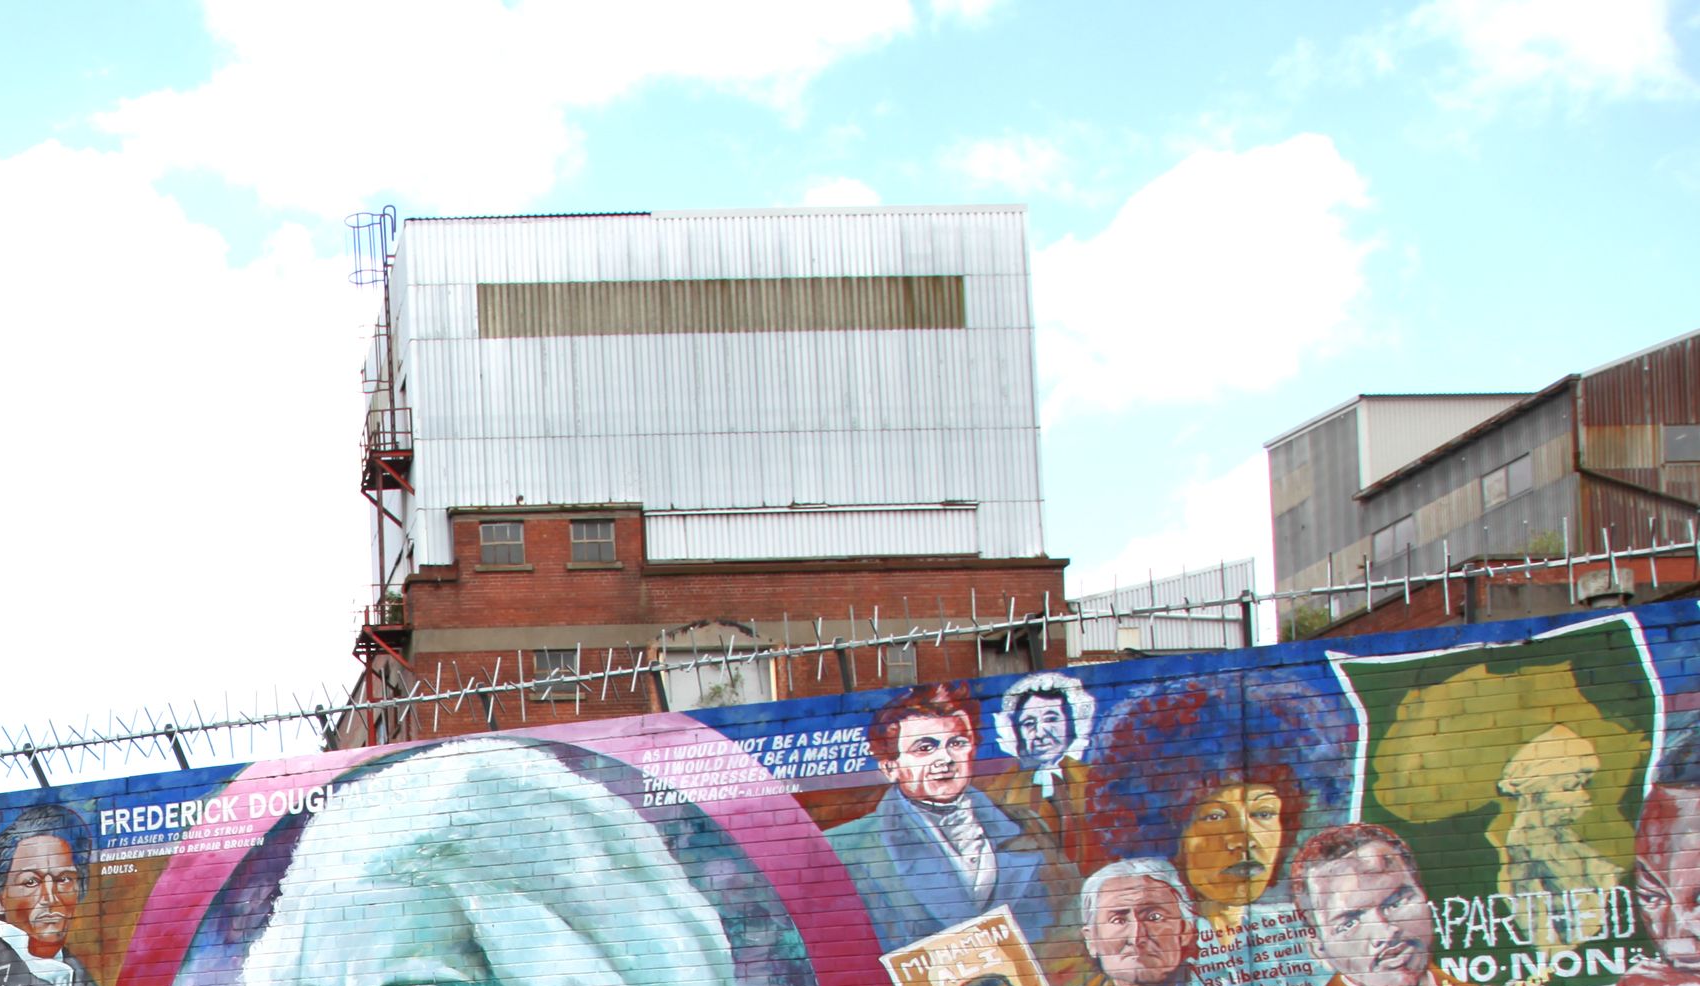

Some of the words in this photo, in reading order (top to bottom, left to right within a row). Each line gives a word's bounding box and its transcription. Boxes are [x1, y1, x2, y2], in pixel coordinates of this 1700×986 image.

[643, 750, 660, 763] AS
[674, 742, 729, 760] WOULD
[732, 737, 766, 754] NOT
[773, 735, 794, 749] BE
[797, 733, 808, 747] A
[812, 727, 867, 745] SLAVE.
[643, 765, 661, 778] SO
[672, 757, 722, 776] WOULD
[727, 754, 762, 770] NOT
[764, 751, 785, 766] BE
[789, 749, 799, 763] A
[804, 742, 873, 761] MASTER.
[643, 778, 675, 792] THIS
[680, 770, 768, 789] EXPRESSES
[773, 765, 796, 778] MY
[800, 761, 837, 776] IDEA
[844, 758, 866, 772] OF
[101, 796, 239, 835] FREDERICK
[100, 851, 144, 862] CHILDREN
[148, 847, 171, 857] THAN
[174, 846, 185, 854] TO
[187, 841, 220, 852] REPAIR
[224, 837, 264, 849] BROKEN
[108, 839, 116, 848] IT
[120, 837, 128, 846] IS
[132, 832, 164, 845] EASIER
[168, 832, 179, 841] TO
[182, 828, 211, 840] BUILD
[214, 824, 253, 836] STRONG
[101, 864, 137, 875] ADULTS.
[1201, 930, 1222, 942] We
[1226, 920, 1259, 935] have
[1262, 917, 1276, 927] to
[1278, 910, 1307, 926] talk
[901, 924, 1009, 981] MUHAMMAD
[1201, 939, 1243, 957] about
[1246, 927, 1317, 946] liberating
[1253, 951, 1269, 963] as
[1274, 943, 1302, 958] well
[1229, 962, 1312, 985] liberating
